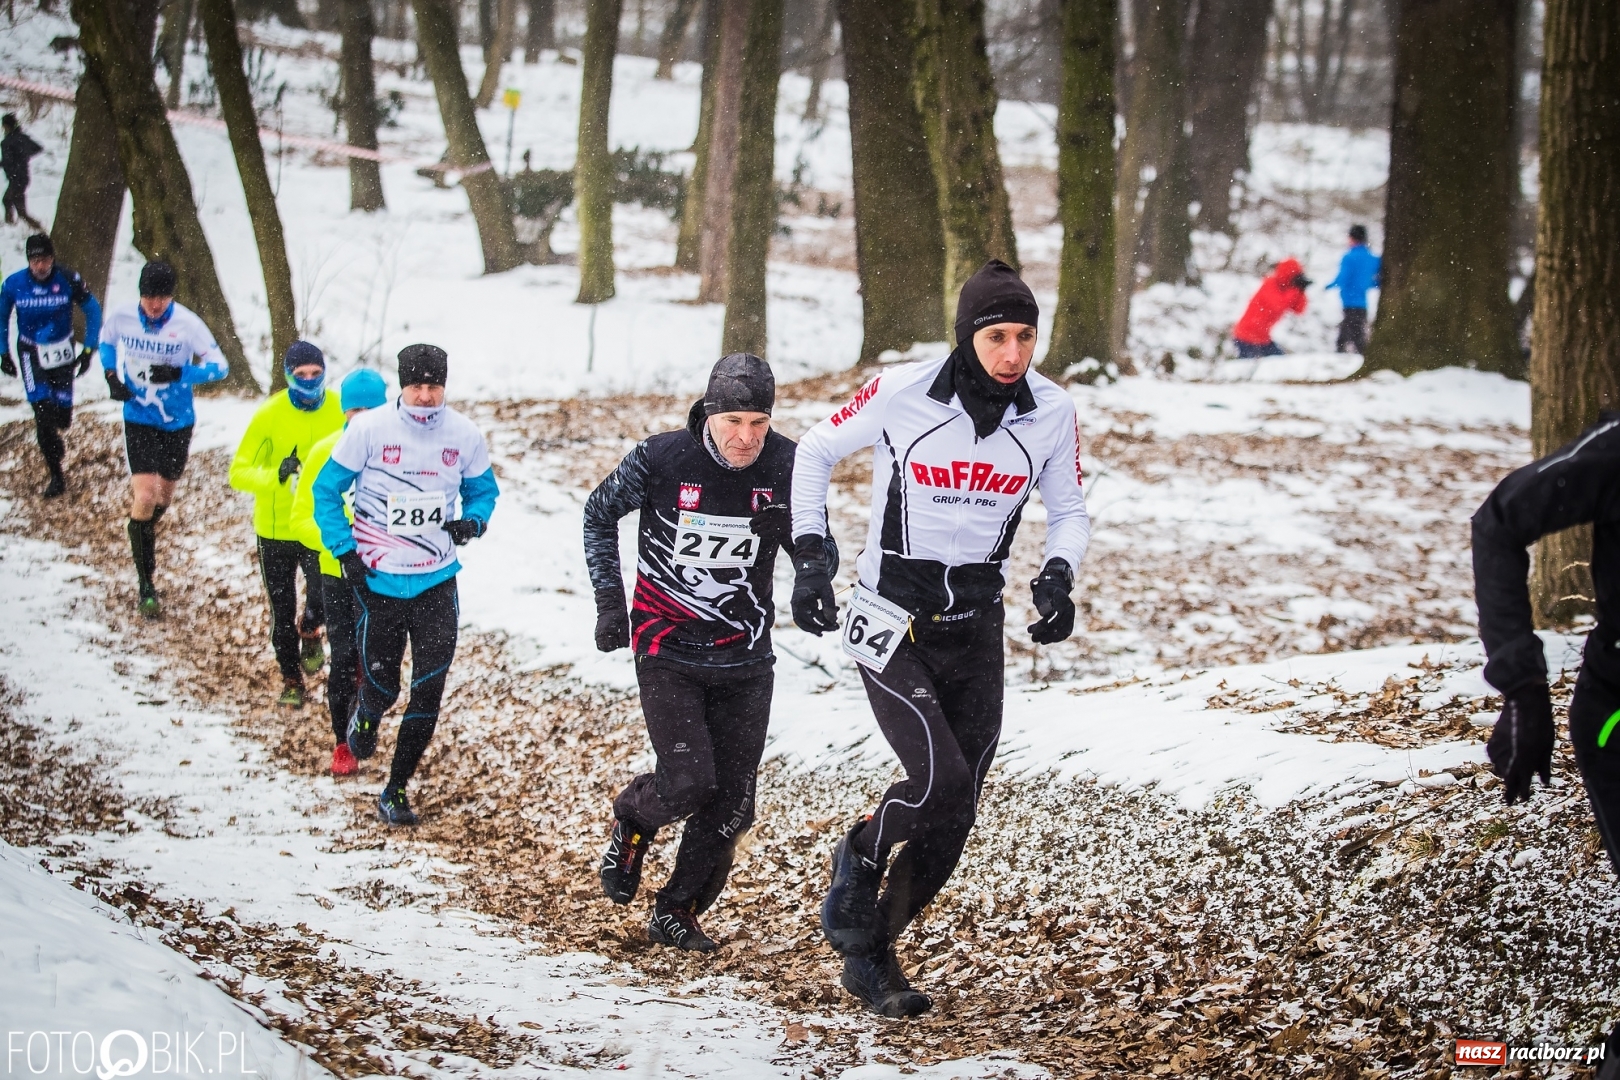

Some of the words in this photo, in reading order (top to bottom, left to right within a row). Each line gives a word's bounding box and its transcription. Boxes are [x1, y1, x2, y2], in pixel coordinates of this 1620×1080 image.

[42, 347, 73, 366] 136
[909, 460, 1029, 495] RAFAKO
[974, 498, 998, 507] PBG
[391, 507, 443, 526] 284
[679, 532, 753, 561] 274
[941, 609, 975, 622] ICEBUG
